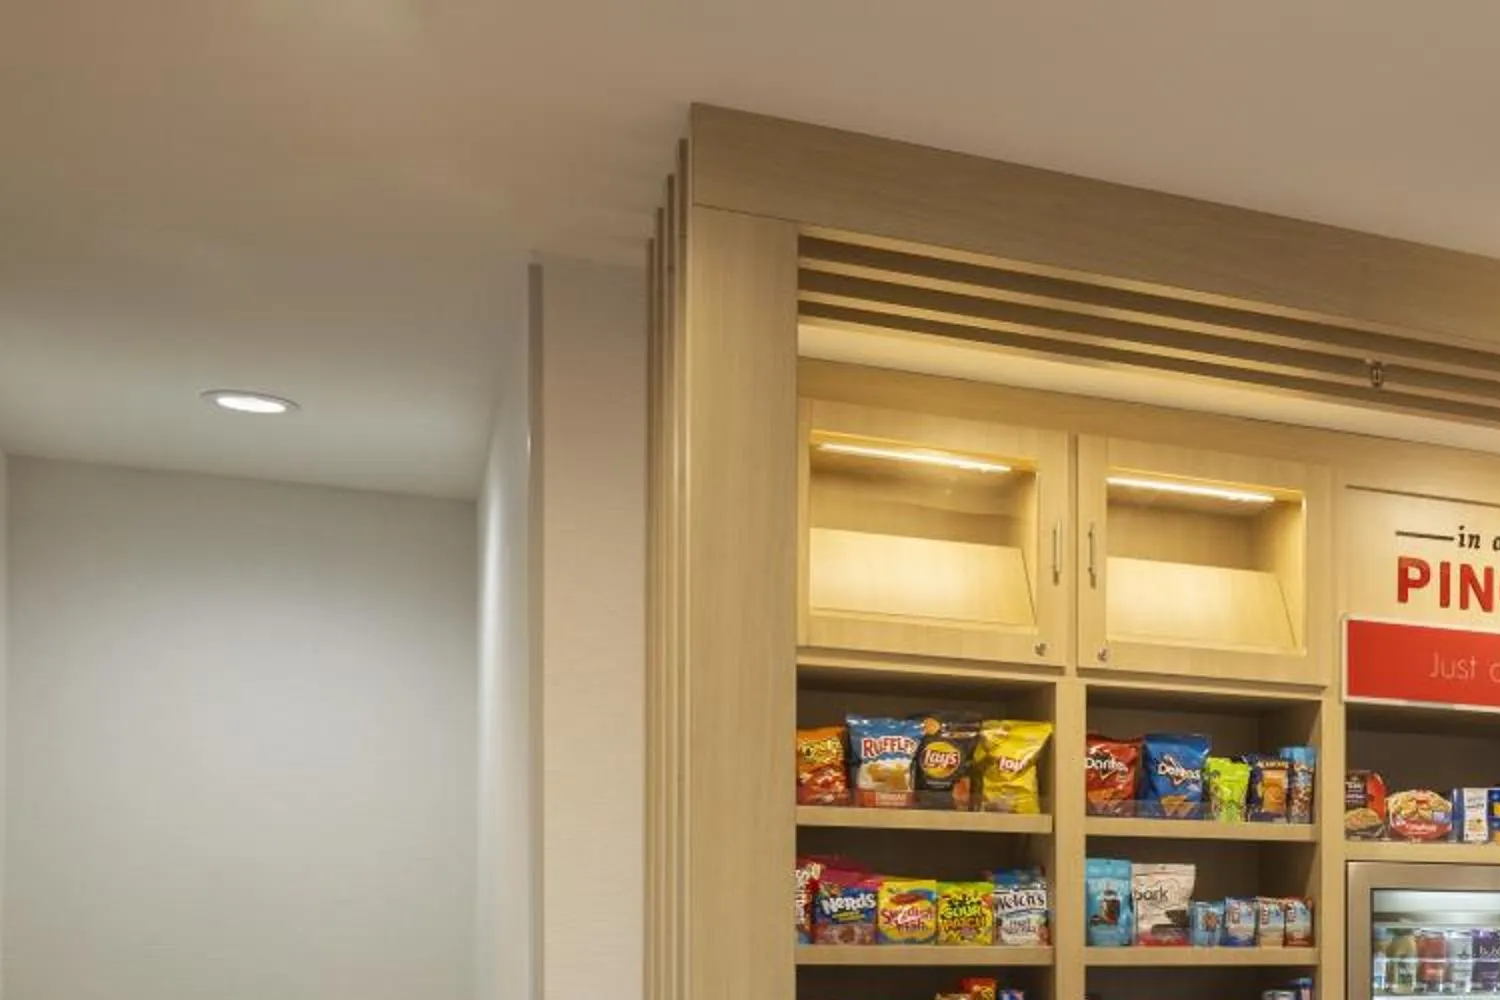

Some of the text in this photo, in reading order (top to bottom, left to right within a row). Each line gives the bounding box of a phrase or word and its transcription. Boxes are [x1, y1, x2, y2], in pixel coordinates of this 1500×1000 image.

[1457, 525, 1481, 550] in
[1428, 652, 1477, 681] Just
[821, 892, 876, 915] Nerds
